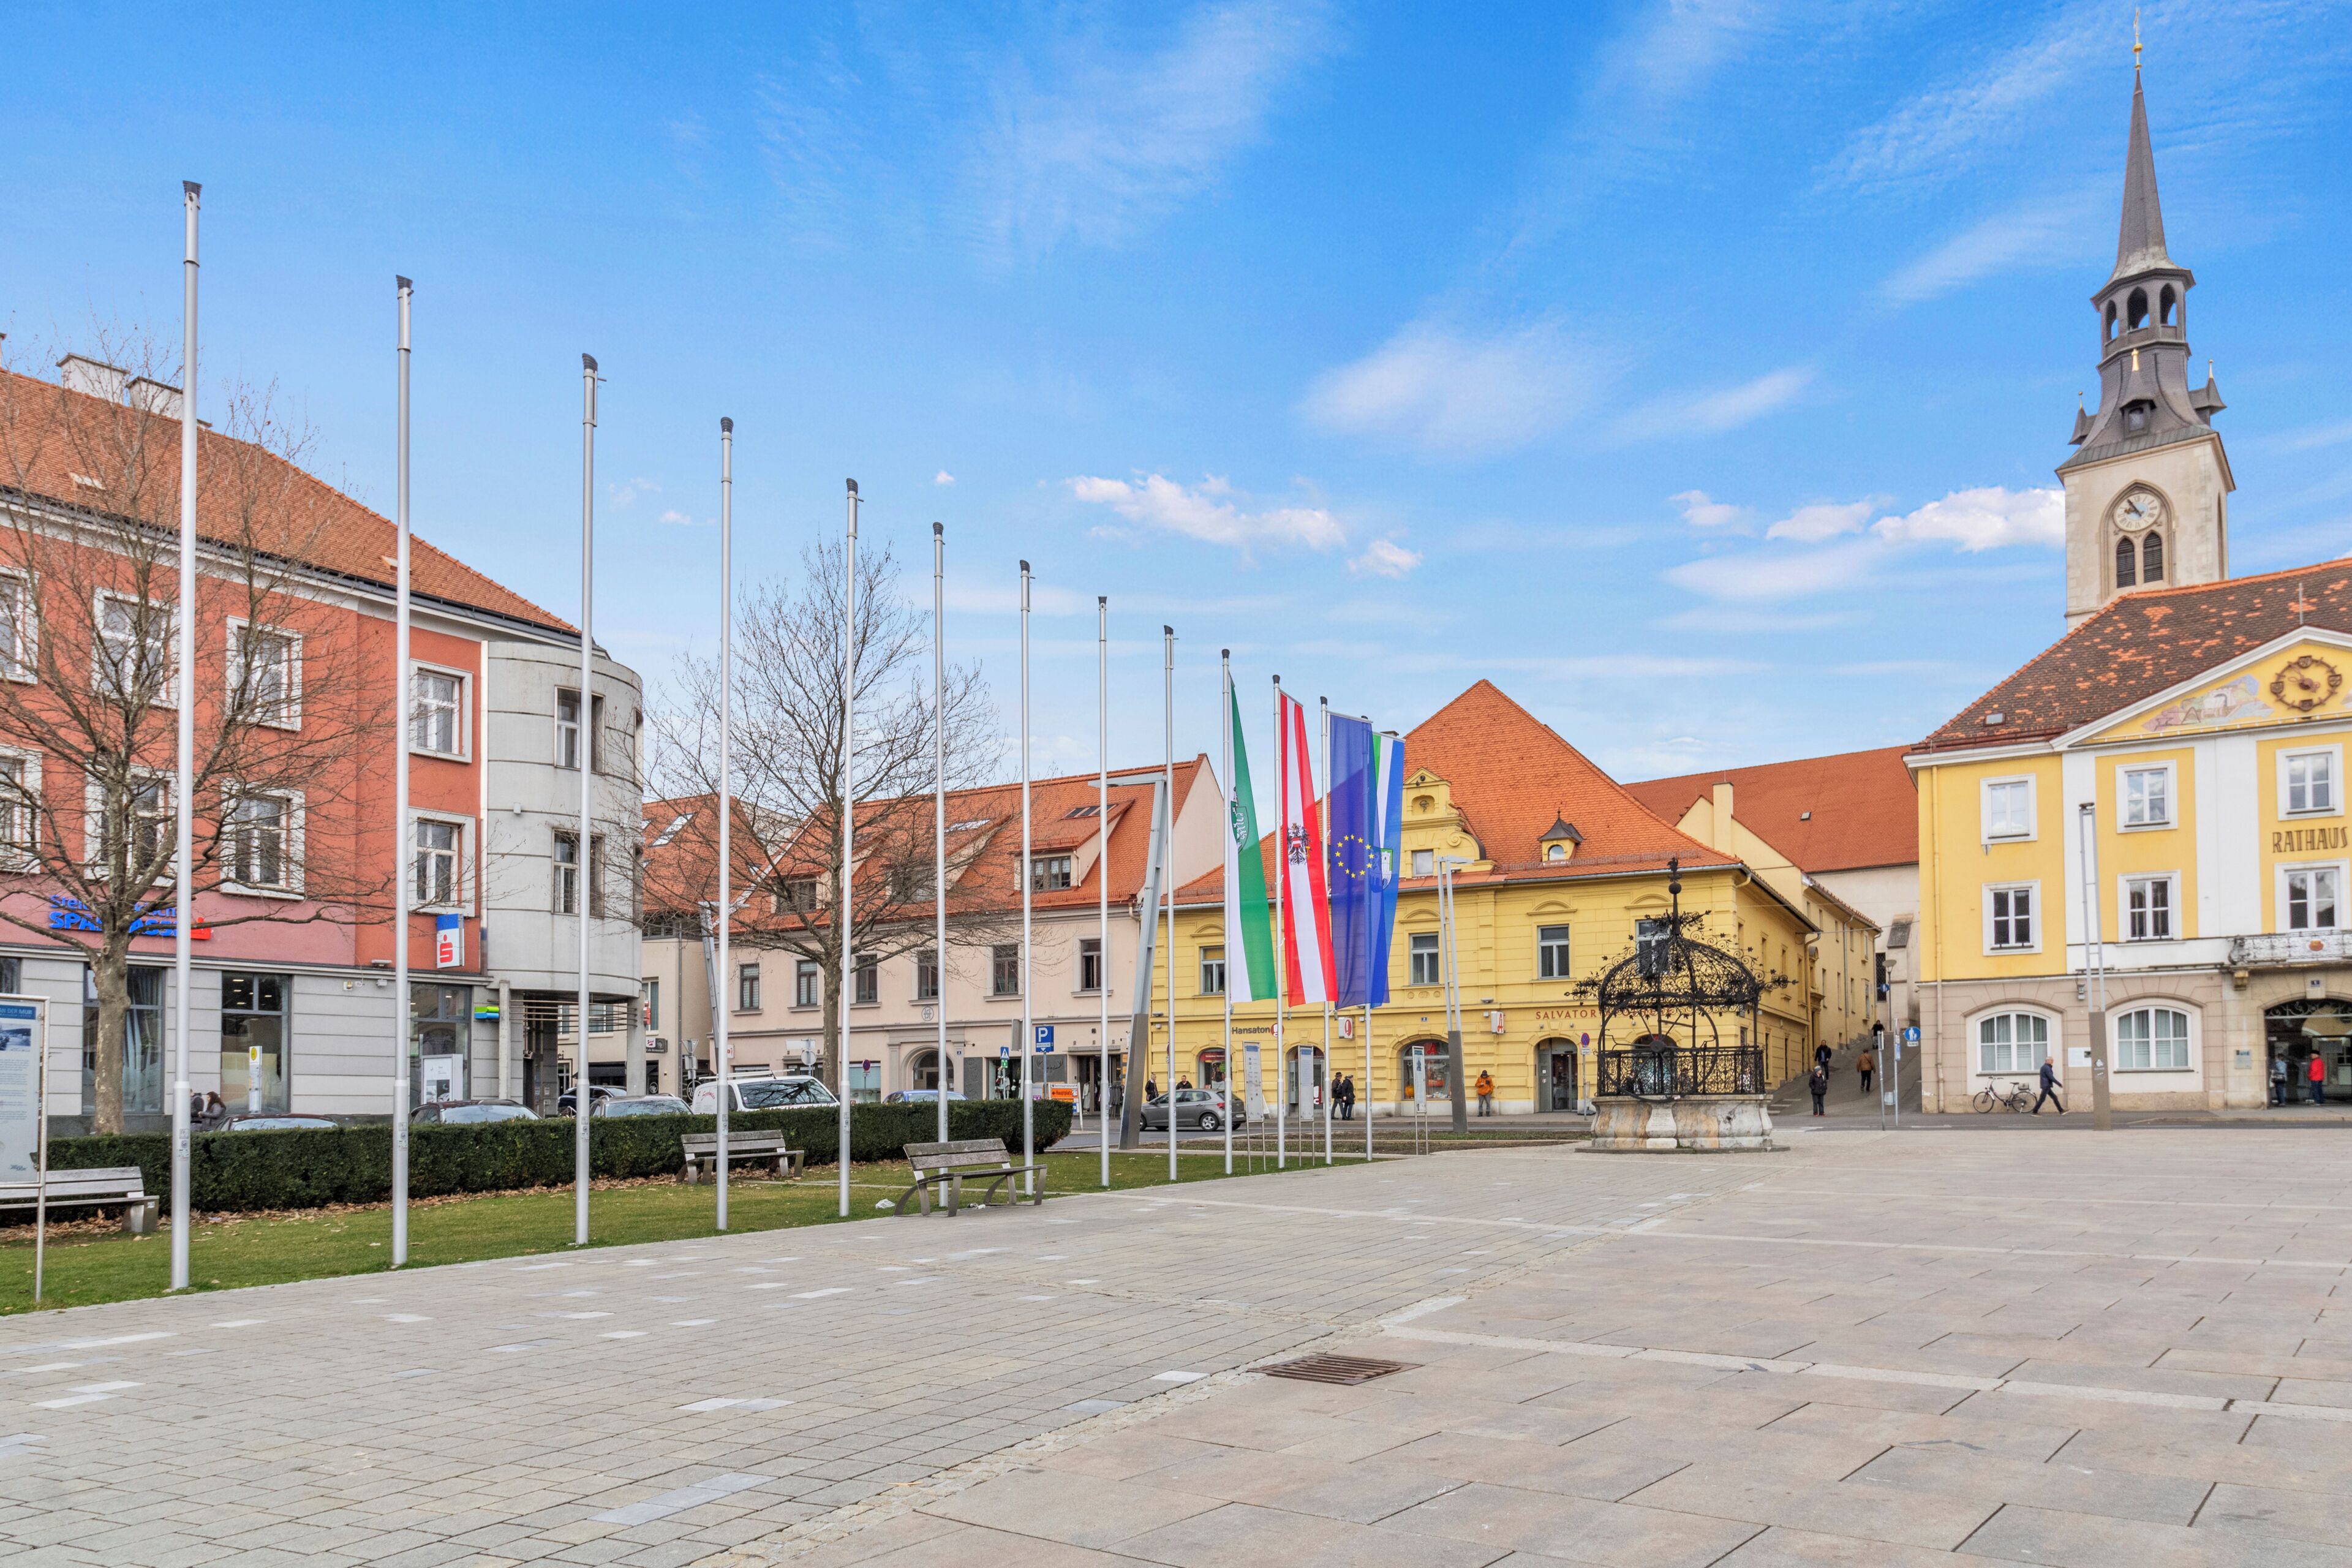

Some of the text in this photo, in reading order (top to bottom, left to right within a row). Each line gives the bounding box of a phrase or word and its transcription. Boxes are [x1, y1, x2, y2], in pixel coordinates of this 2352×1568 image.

[2272, 826, 2348, 853] RATHAUS
[1536, 1009, 1597, 1020] SALVATOR
[1038, 1027, 1048, 1042] P
[1232, 1026, 1270, 1035] Hansaton
